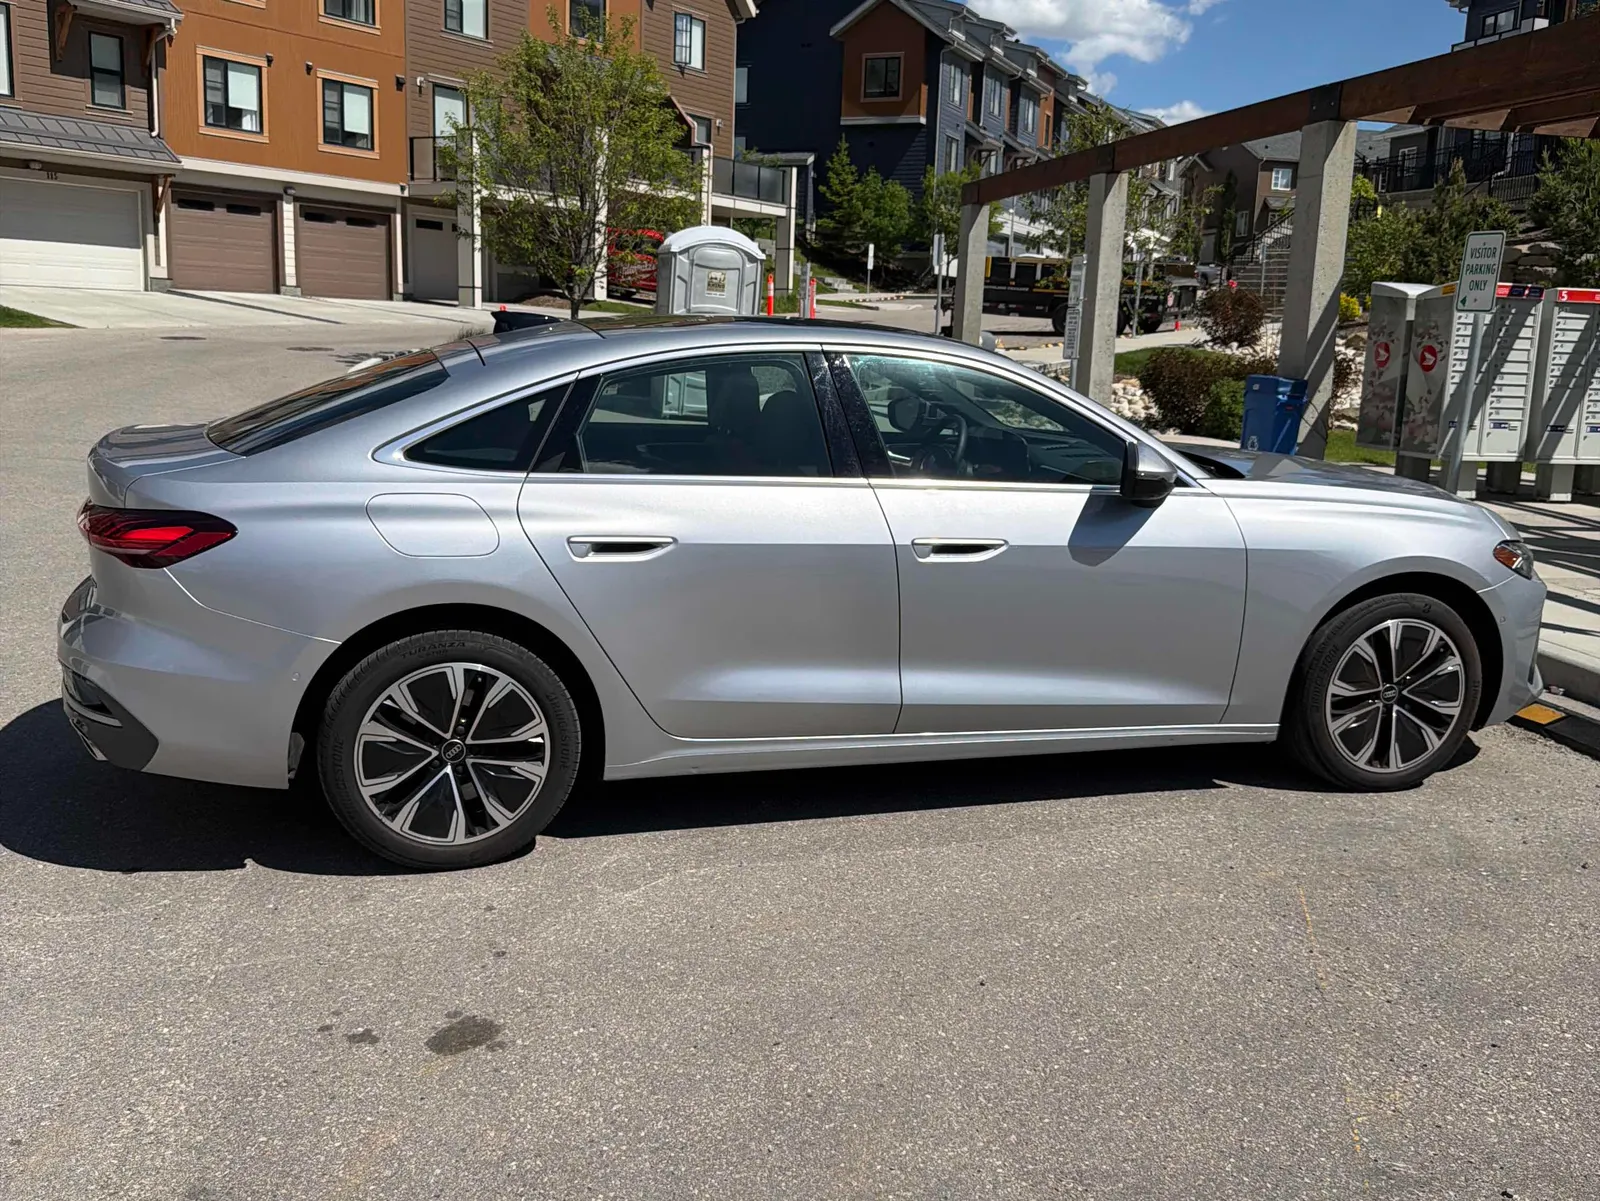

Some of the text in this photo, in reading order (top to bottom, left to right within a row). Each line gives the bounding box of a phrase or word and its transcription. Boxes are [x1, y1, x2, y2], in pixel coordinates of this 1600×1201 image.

[1470, 246, 1497, 259] VISITOR
[1465, 263, 1497, 275] PARKING
[1469, 279, 1488, 292] ONLY
[1560, 290, 1569, 301] 5
[400, 641, 466, 659] TURANZA
